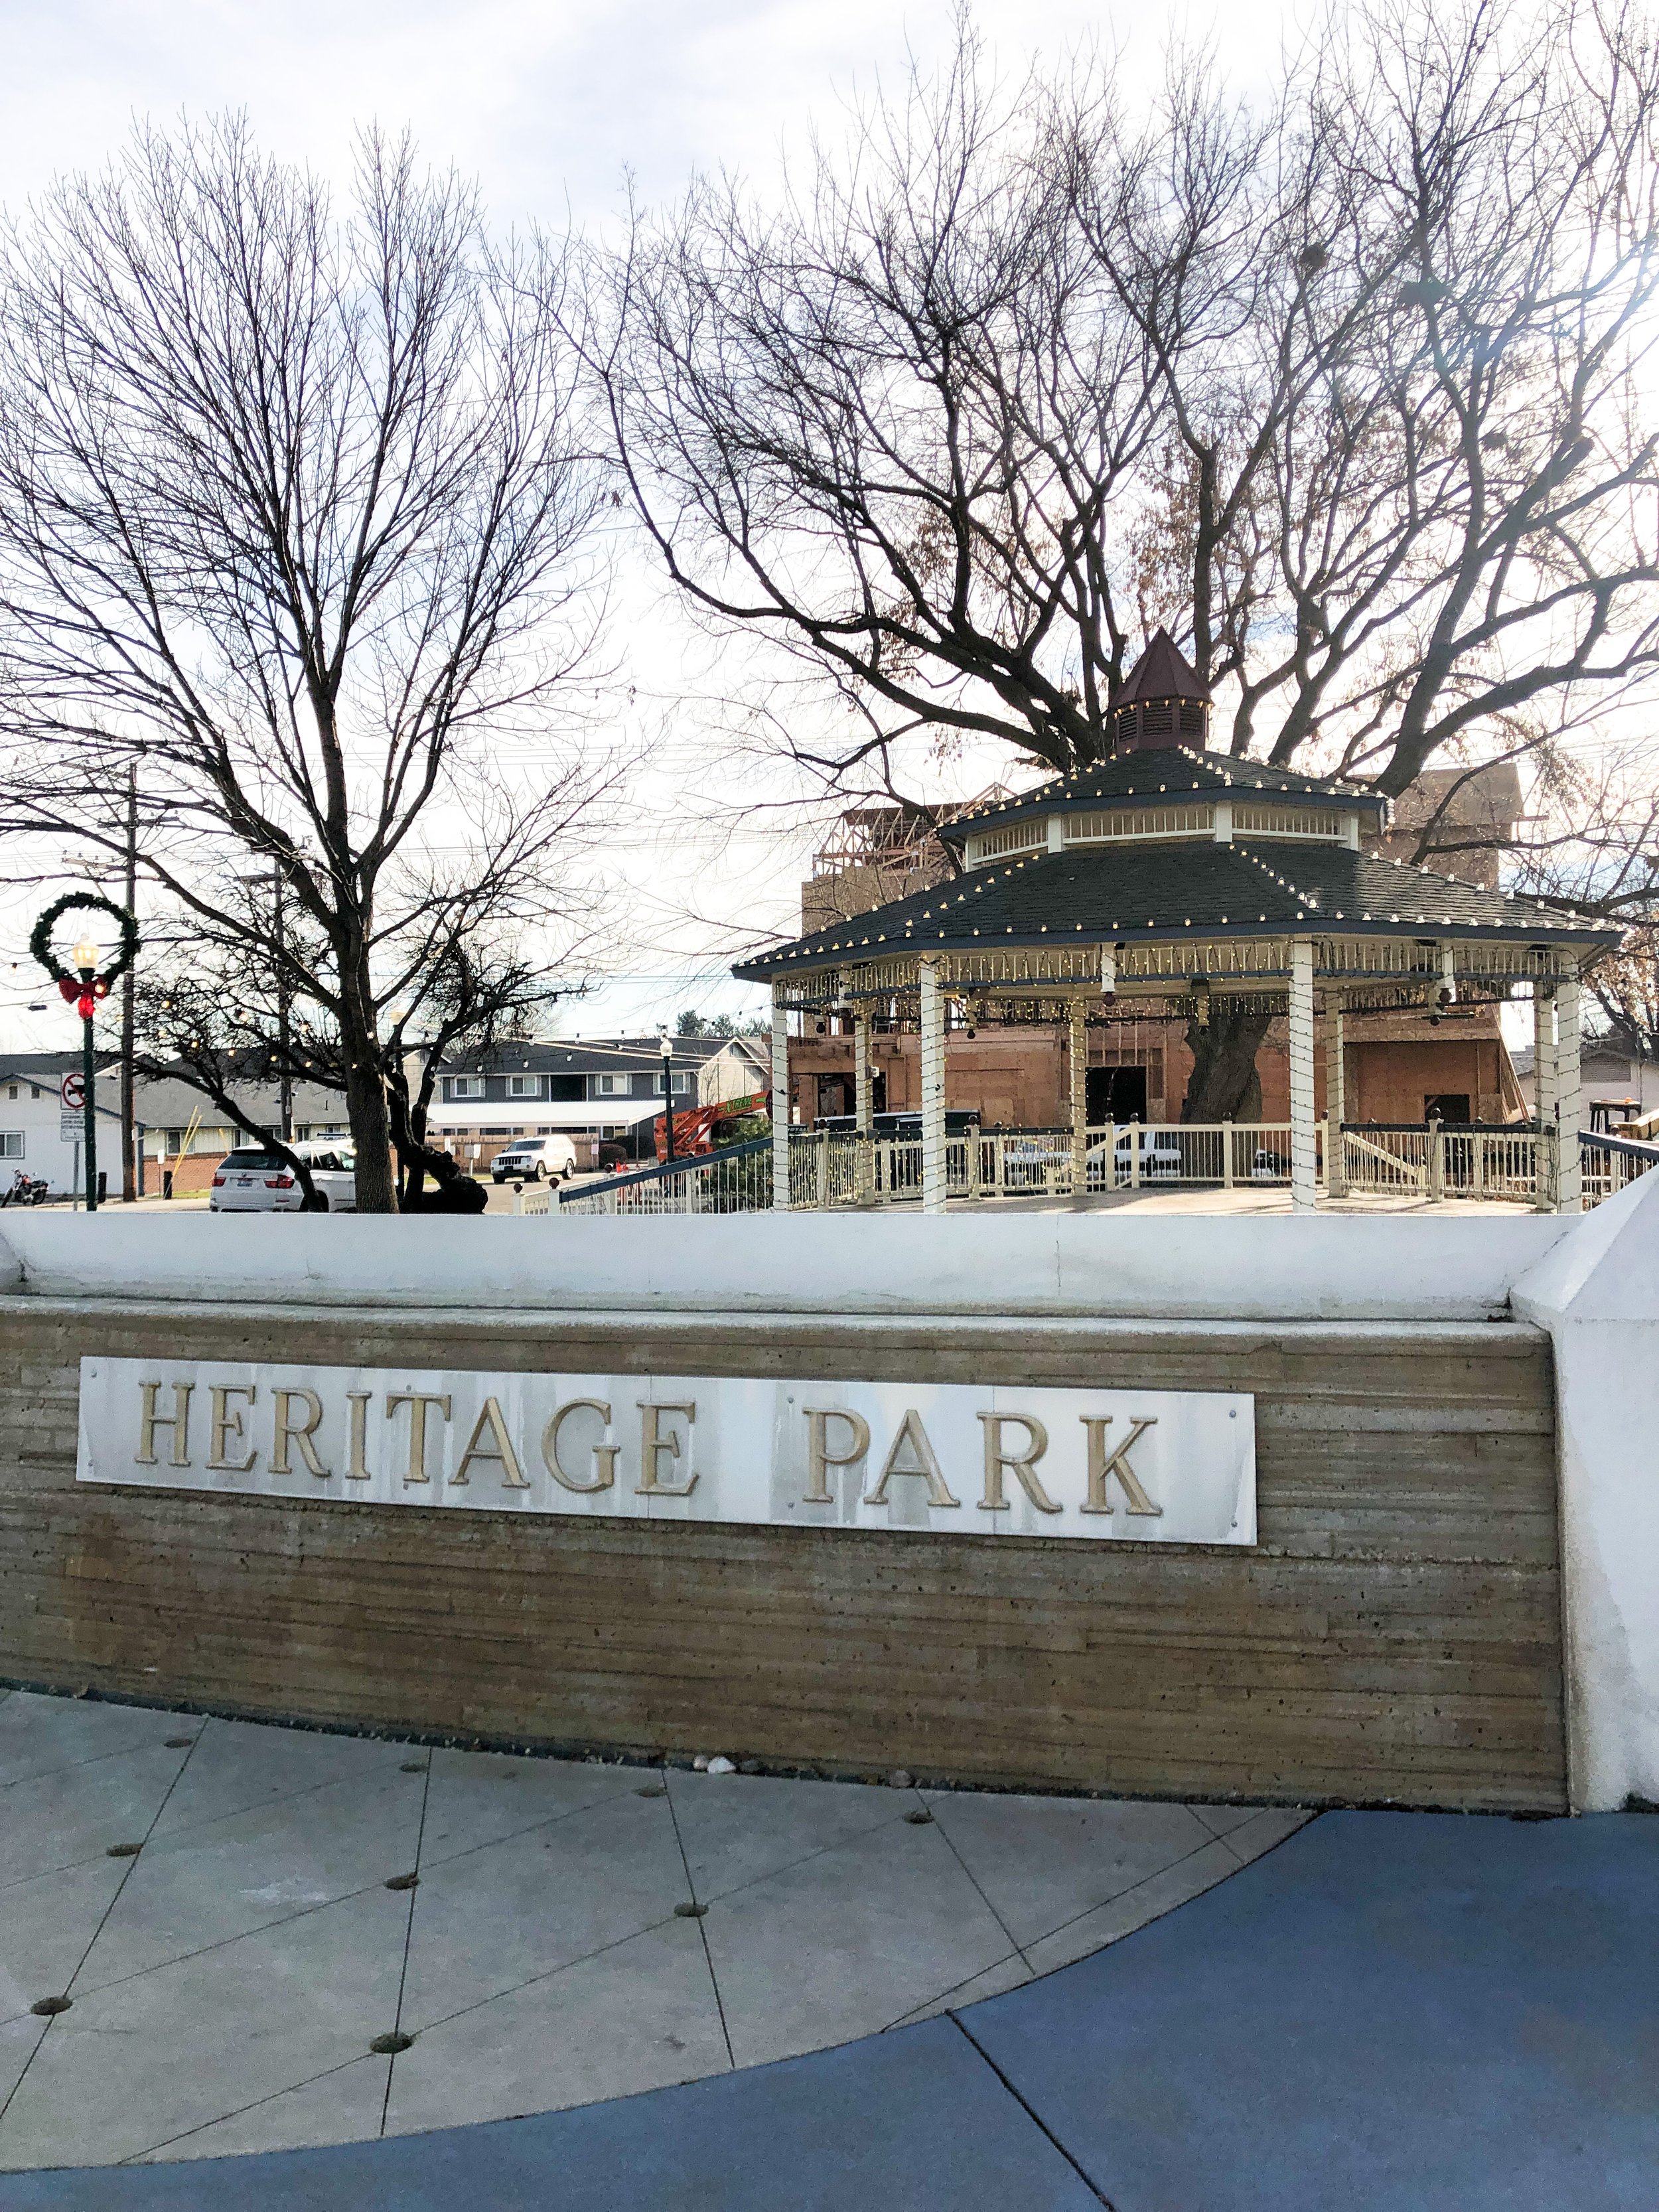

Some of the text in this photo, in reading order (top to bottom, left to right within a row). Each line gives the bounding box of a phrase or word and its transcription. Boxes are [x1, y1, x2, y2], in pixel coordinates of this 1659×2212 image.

[724, 1096, 753, 1114] XTREME
[134, 1380, 1164, 1517] HERITAGE PARK
